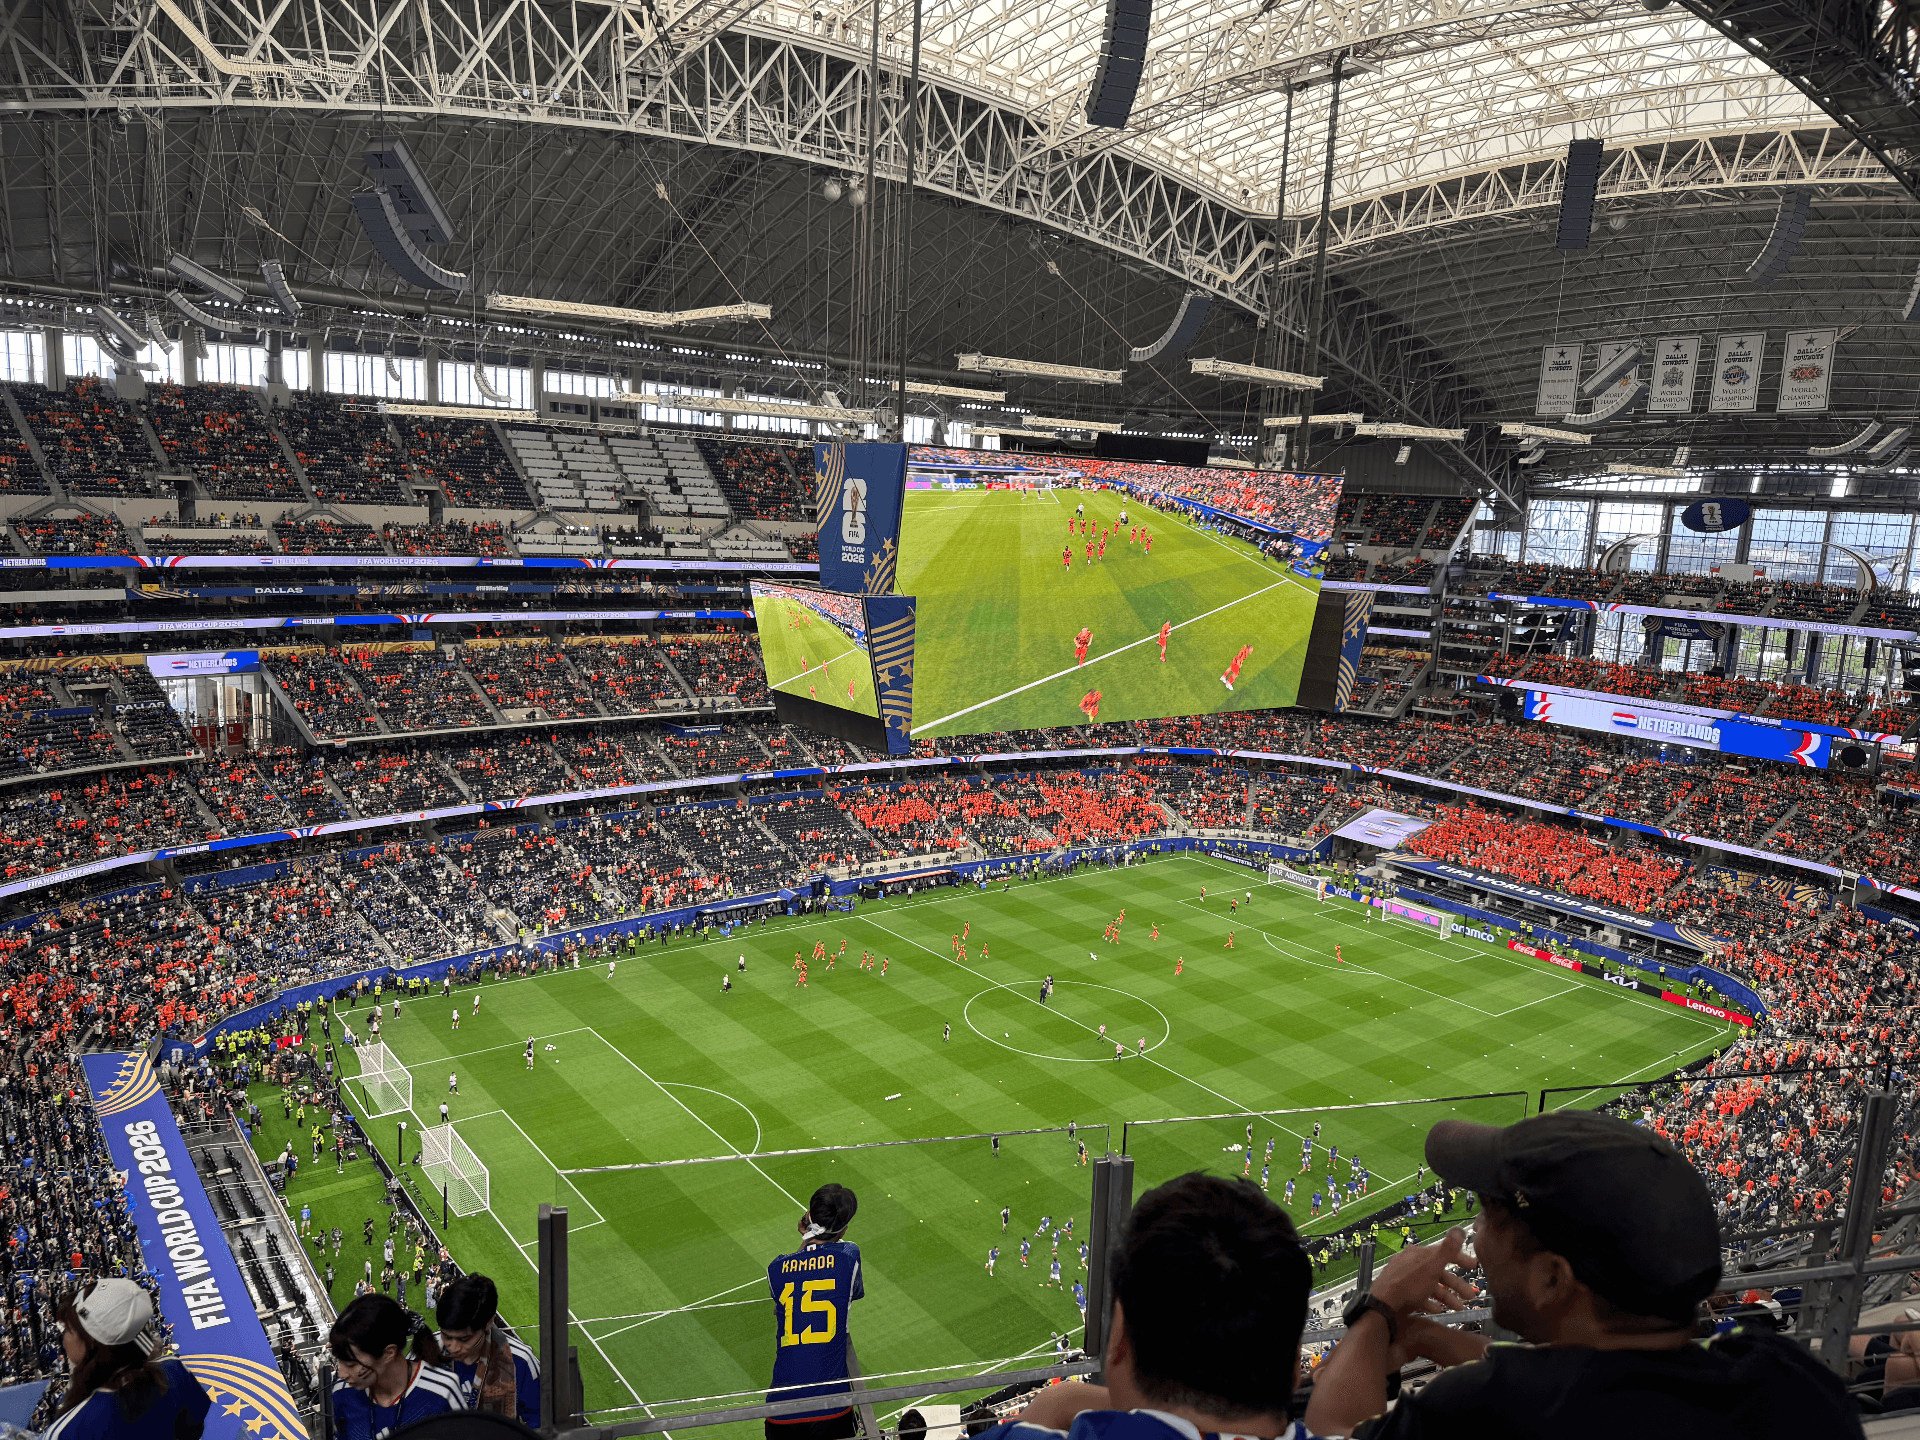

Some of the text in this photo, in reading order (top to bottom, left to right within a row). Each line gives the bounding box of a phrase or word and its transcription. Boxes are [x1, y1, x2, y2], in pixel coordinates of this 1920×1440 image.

[848, 530, 860, 539] FIFA
[841, 544, 866, 554] WORLD CUP
[2, 558, 47, 567] NETHERLANDS
[841, 552, 865, 564] 2026
[175, 622, 203, 630] WORLD
[203, 621, 218, 629] CUP
[218, 620, 244, 628] 2026
[1781, 620, 1865, 634] FIFA WORLD CUP 2026
[188, 657, 238, 669] NETHERLANDS
[1630, 698, 1644, 706] FIFA
[1644, 699, 1665, 708] WORLD
[1665, 702, 1678, 710] CUP
[1637, 715, 1720, 744] NETHERLANDS
[27, 878, 43, 889] FIFA
[43, 872, 68, 886] WORLD
[68, 868, 83, 879] CUP
[1284, 871, 1313, 886] AIRWAYS
[1334, 885, 1352, 899] VISA
[1436, 864, 1655, 927] FIFA WORLD CUP 2026
[1450, 922, 1496, 943] aramco
[1685, 998, 1726, 1018] Lenovo
[124, 1120, 231, 1331] FIFA WORLD CUP 2026
[782, 1254, 835, 1274] KAMADA
[779, 1278, 837, 1347] 15
